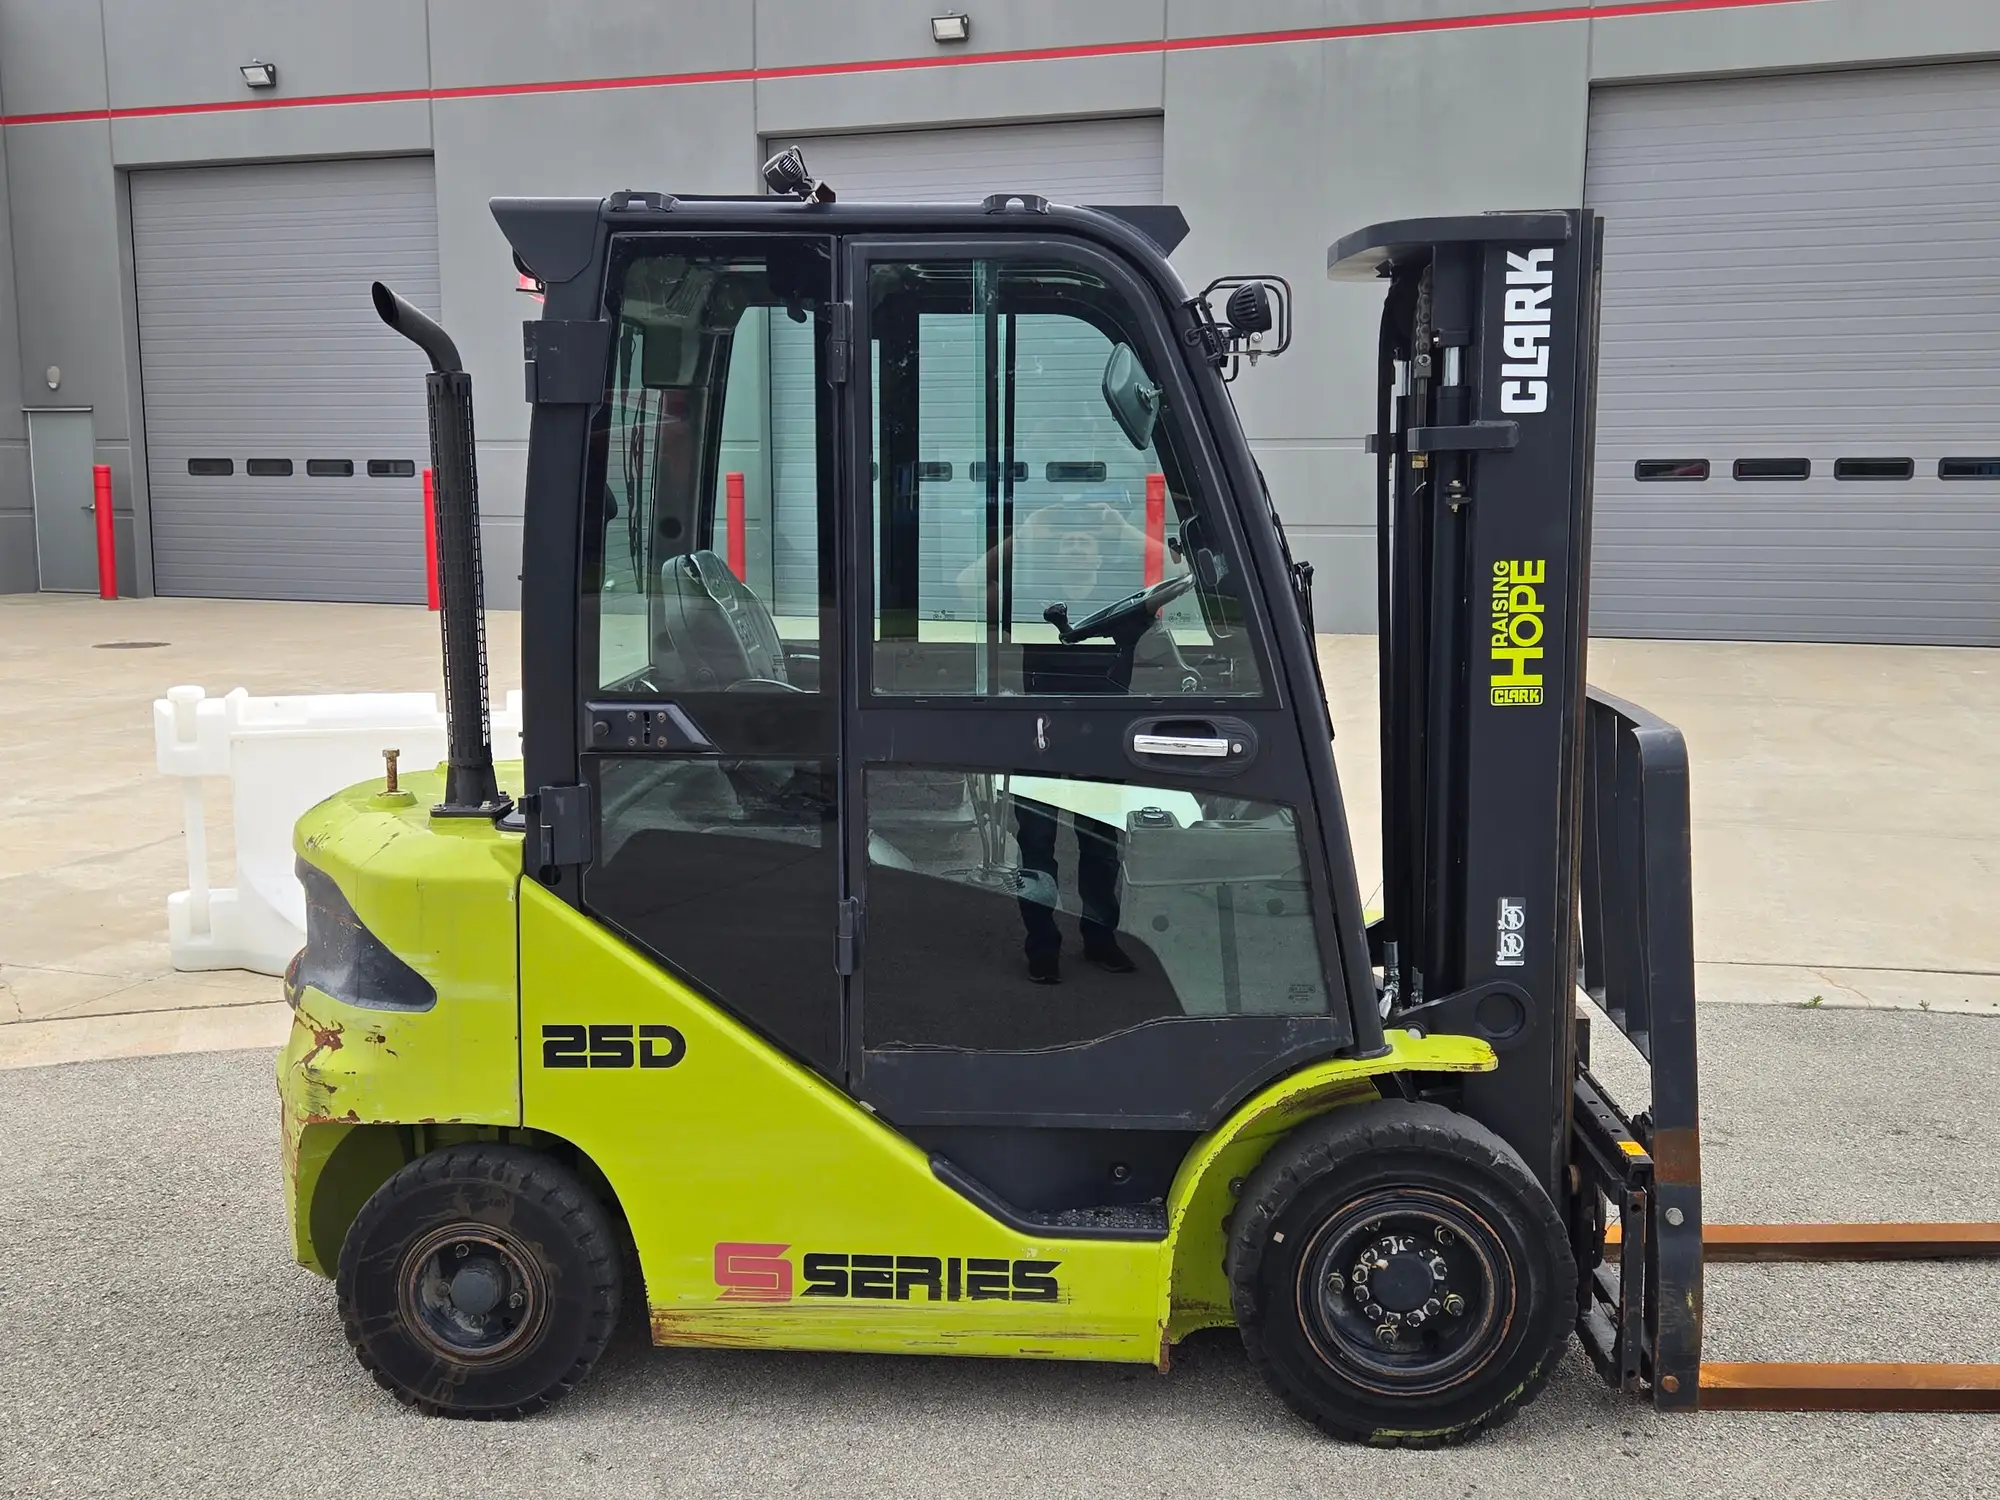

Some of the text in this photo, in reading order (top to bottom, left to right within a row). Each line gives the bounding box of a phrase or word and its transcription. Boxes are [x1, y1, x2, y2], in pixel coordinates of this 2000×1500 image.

[1501, 248, 1554, 413] CLARK
[1490, 559, 1545, 687] HOPE
[1492, 560, 1509, 647] RAISING
[1494, 689, 1540, 704] CLARK
[541, 1024, 687, 1069] 25D
[714, 1242, 1063, 1304] S SERIES
